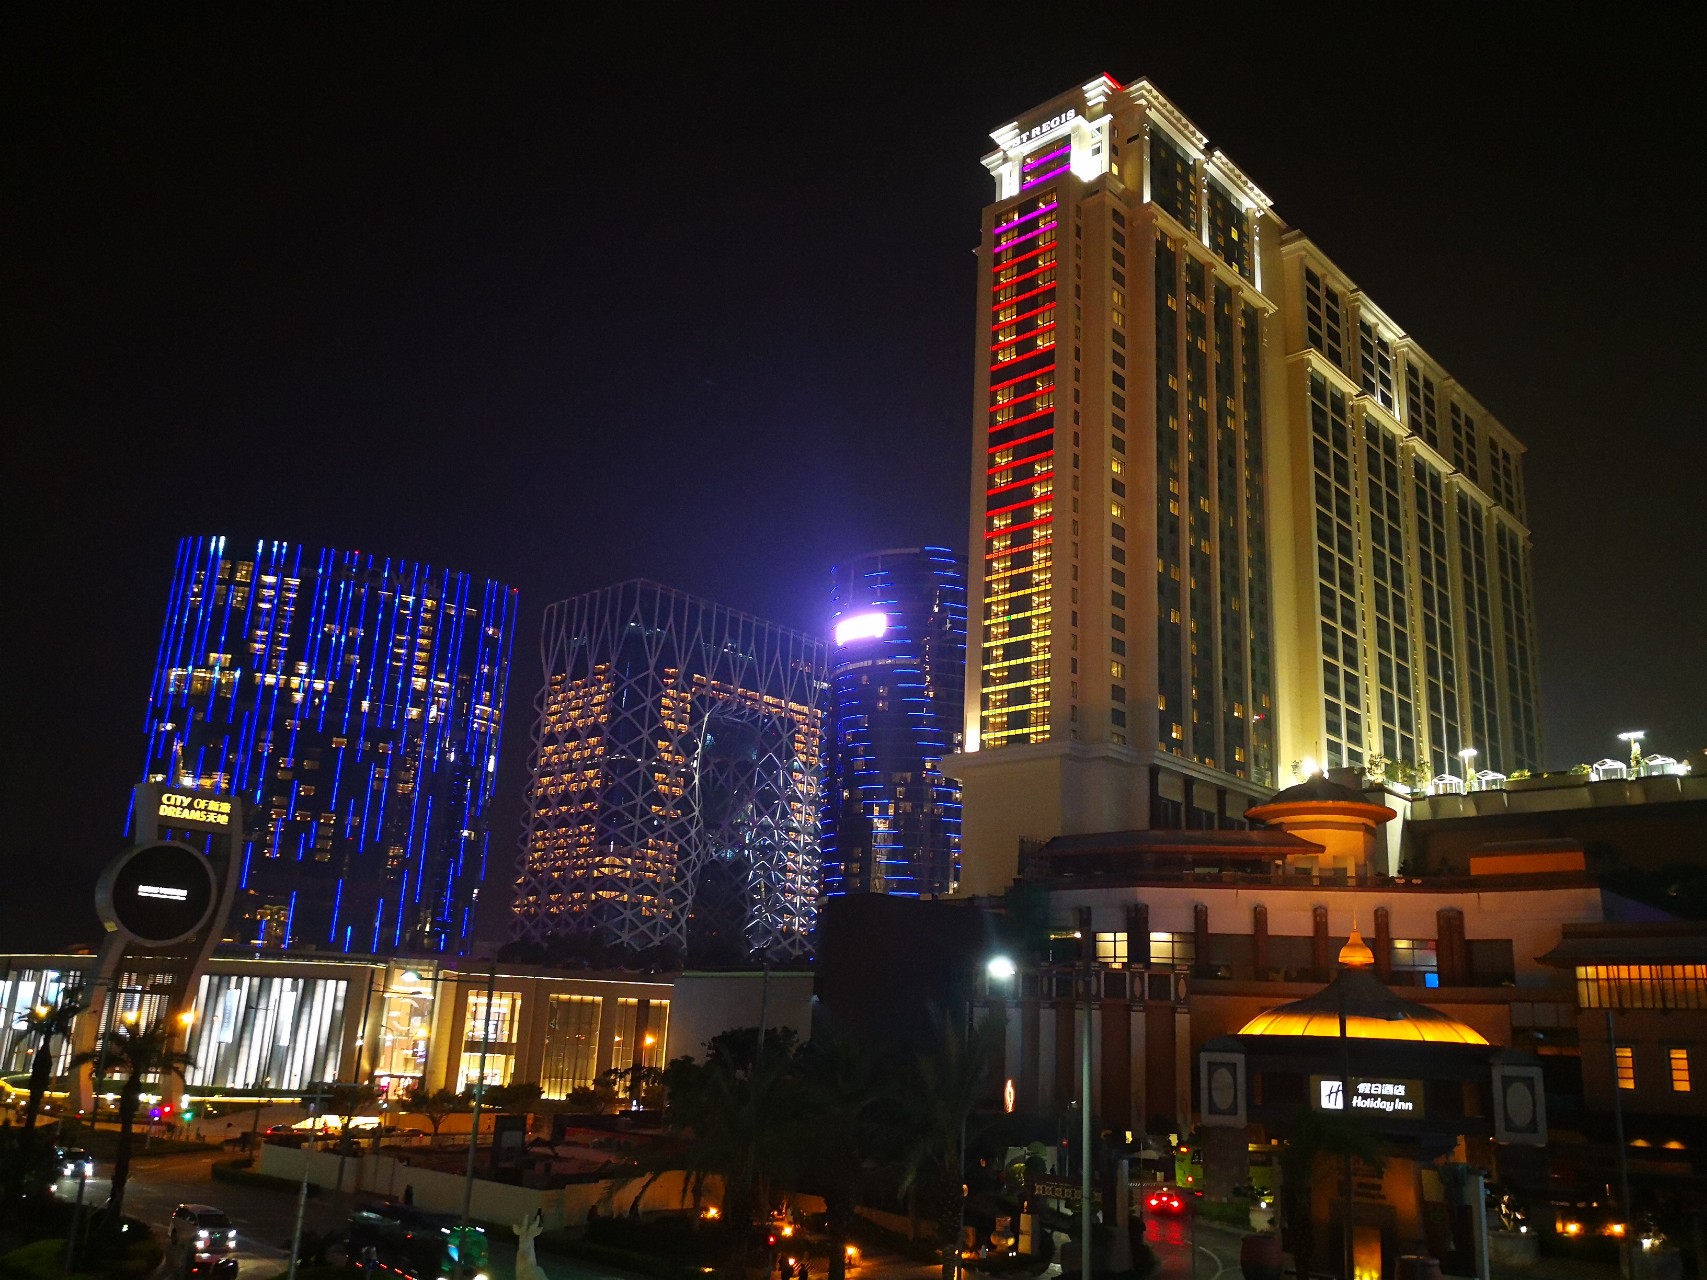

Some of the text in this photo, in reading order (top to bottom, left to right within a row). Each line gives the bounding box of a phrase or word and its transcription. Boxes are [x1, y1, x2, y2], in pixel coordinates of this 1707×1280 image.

[1031, 109, 1076, 138] REGIS
[161, 793, 208, 809] CITY OF
[159, 804, 206, 821] DREAMS
[1357, 1083, 1405, 1096] 假日酒店
[1352, 1095, 1413, 1112] Holiday Inn
